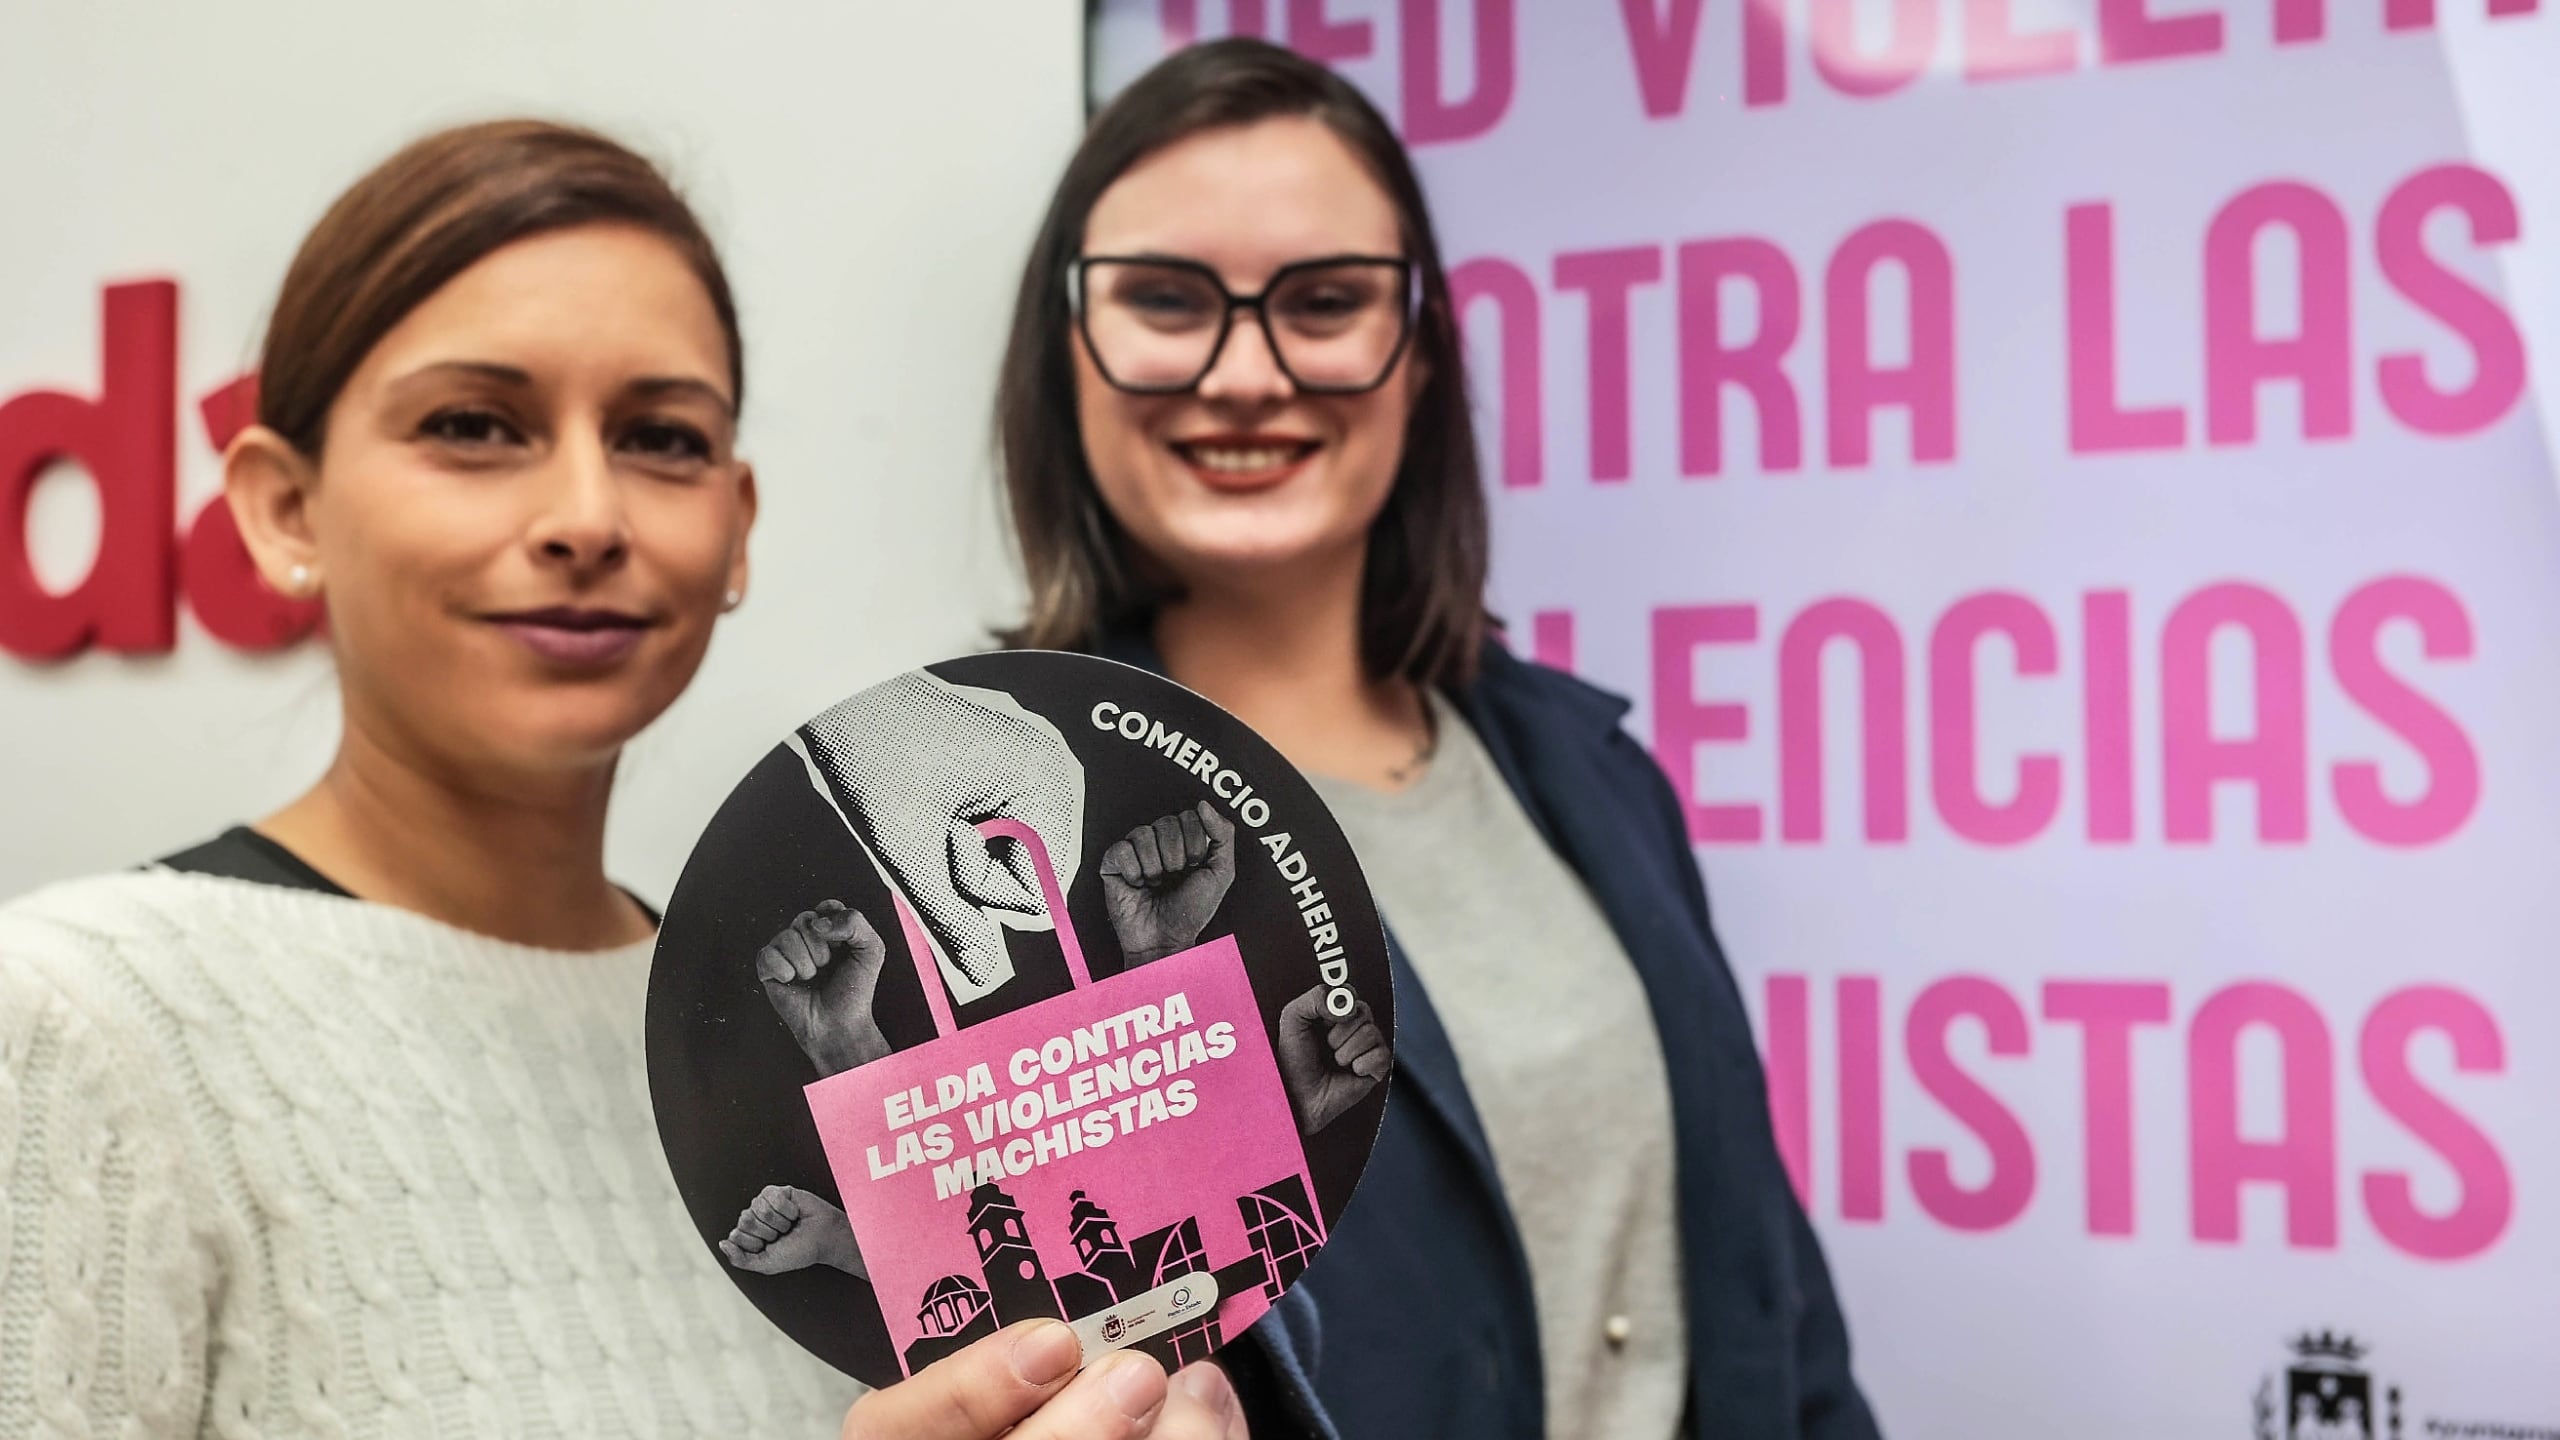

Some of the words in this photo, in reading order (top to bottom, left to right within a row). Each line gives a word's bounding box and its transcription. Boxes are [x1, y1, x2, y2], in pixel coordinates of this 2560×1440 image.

[1447, 217, 1959, 490] NTRA
[2064, 161, 2529, 457] LAS
[1091, 701, 1270, 828] COMERCIO
[1259, 832, 1354, 1017] ADHERIDO
[866, 1123, 954, 1181] LAS
[964, 1021, 1237, 1144] VIOLENCIAS
[883, 1062, 997, 1131] ELDA
[1009, 992, 1195, 1086] CONTRA
[933, 1079, 1198, 1201] MACHISTAS
